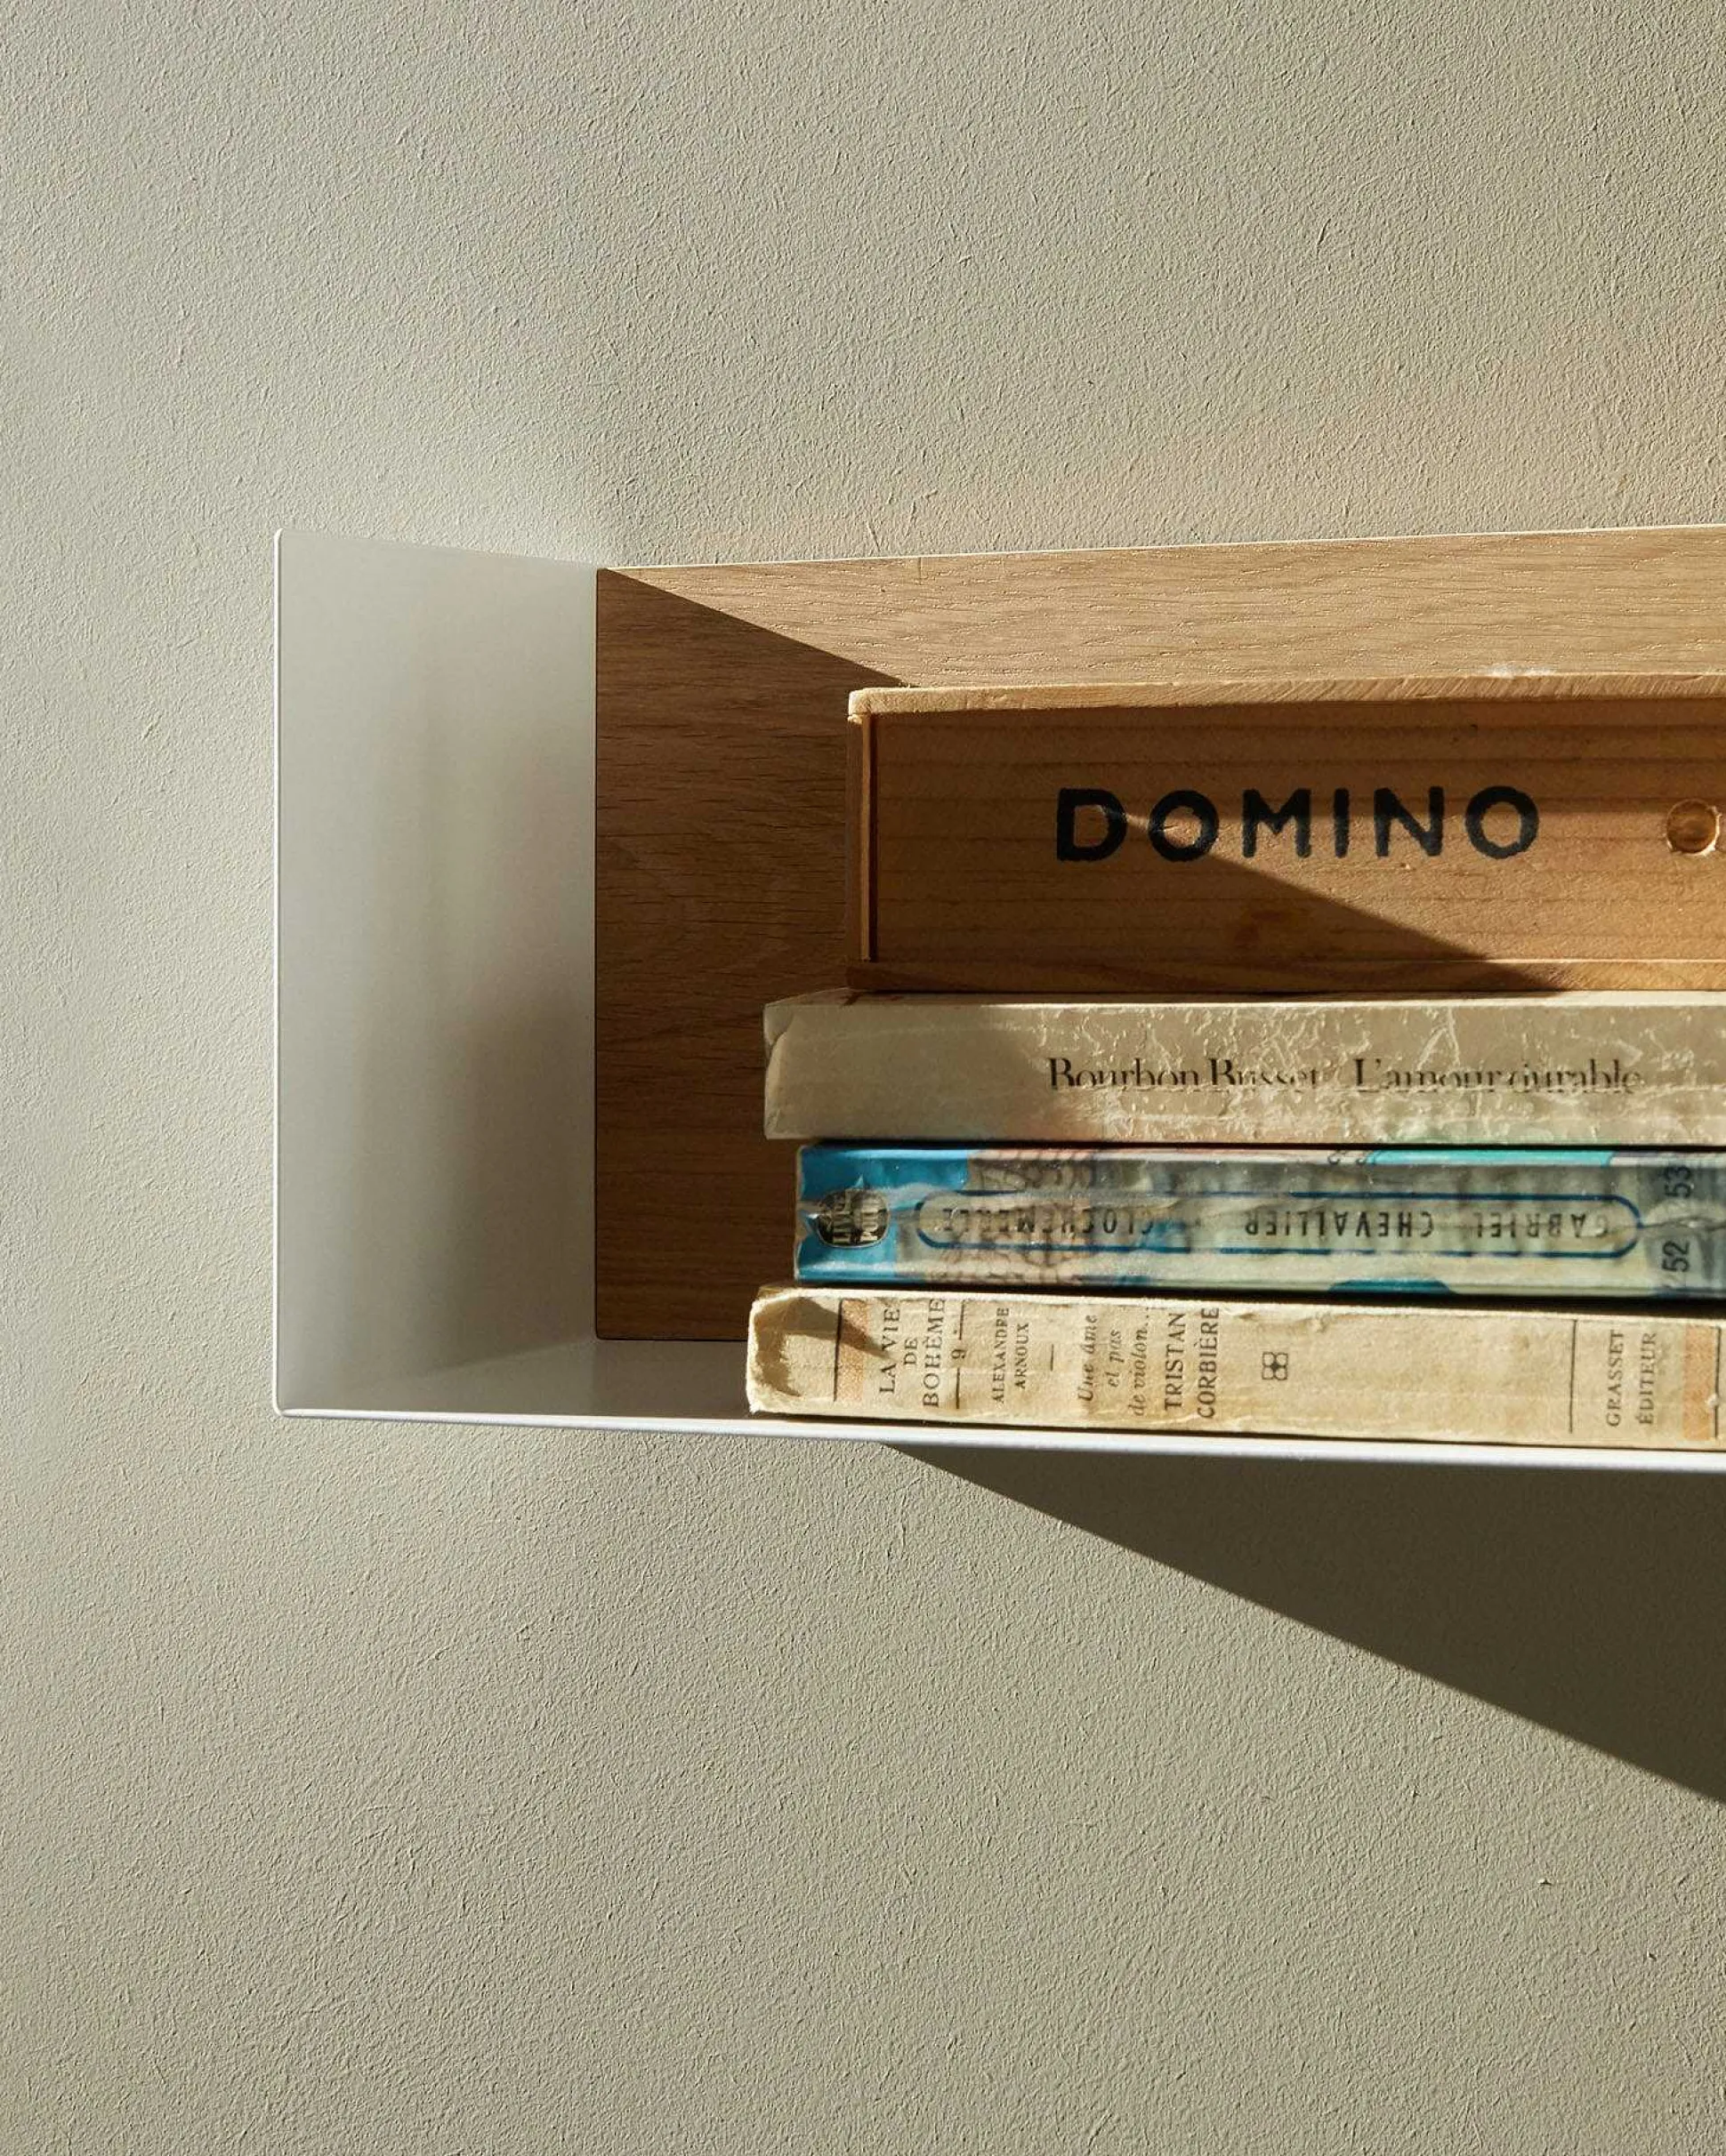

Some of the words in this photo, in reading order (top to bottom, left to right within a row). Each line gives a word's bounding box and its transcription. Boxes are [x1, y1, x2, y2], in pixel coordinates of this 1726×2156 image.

[1057, 786, 1538, 861] DOMINO
[1049, 1058, 1198, 1090] Bourbon
[1354, 1058, 1501, 1092] L'amour
[1246, 1211, 1433, 1238] CHEVALLIER
[1473, 1211, 1609, 1239] GABRIEL
[882, 1308, 900, 1351] VIE
[1080, 1315, 1098, 1354] âme
[1109, 1329, 1125, 1363] pas
[904, 1337, 918, 1366] DE
[923, 1299, 945, 1409] BOHÈME
[992, 1307, 1010, 1404] ALEXANDRE
[1014, 1323, 1028, 1389] ARNOUX
[1165, 1313, 1186, 1411] TRISTAN
[1193, 1307, 1219, 1420] CORBIÈRE
[879, 1364, 897, 1394] LA
[1077, 1364, 1094, 1402] Une
[1606, 1330, 1625, 1428] GRASSET
[1634, 1332, 1657, 1426] ÉDITEUR
[1127, 1394, 1146, 1416] de
